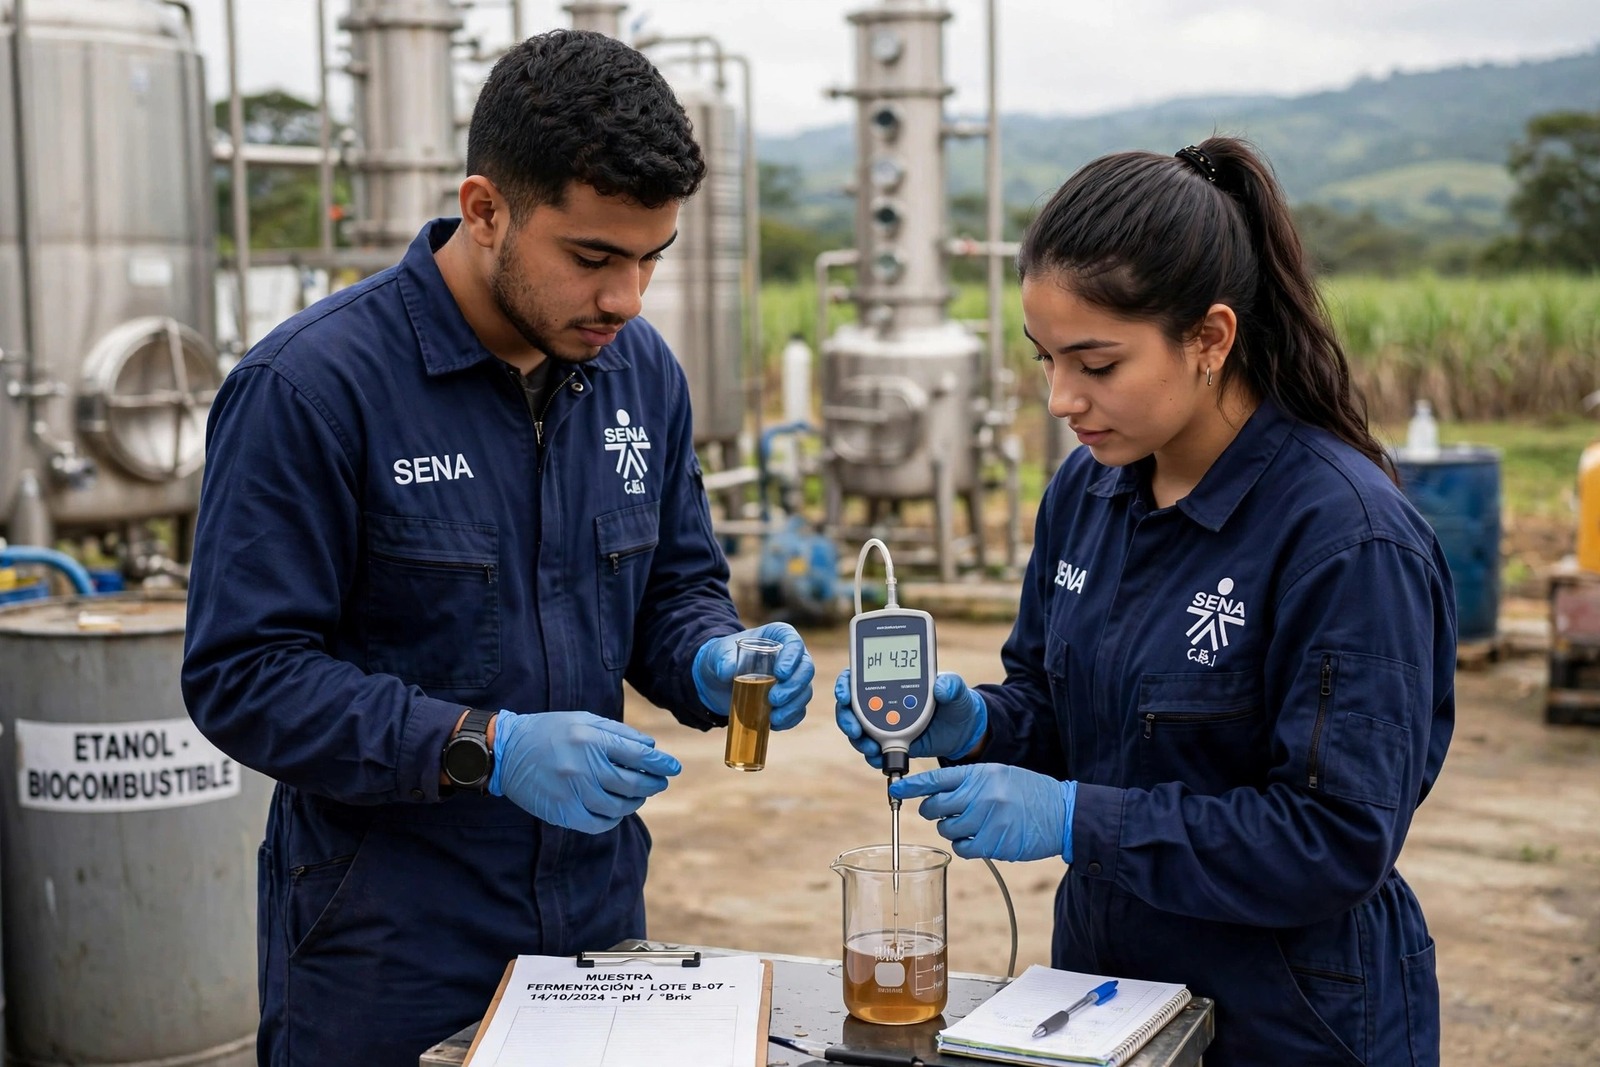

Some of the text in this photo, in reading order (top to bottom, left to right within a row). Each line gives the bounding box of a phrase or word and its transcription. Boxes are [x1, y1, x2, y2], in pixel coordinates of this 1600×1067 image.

[604, 426, 648, 442] SENA
[393, 453, 474, 485] SENA
[1192, 591, 1245, 617] SENA
[867, 650, 918, 669] pH 4.32
[74, 732, 174, 761] ETANOL
[27, 760, 232, 800] BIOCOMBUSTIBLE
[526, 982, 634, 991] FERMENTACIÓN
[650, 983, 687, 991] LOTE
[692, 982, 723, 991] B-07
[586, 973, 653, 981] MUESTRA
[530, 993, 605, 1001] 14/10/2024
[622, 993, 641, 1003] pH
